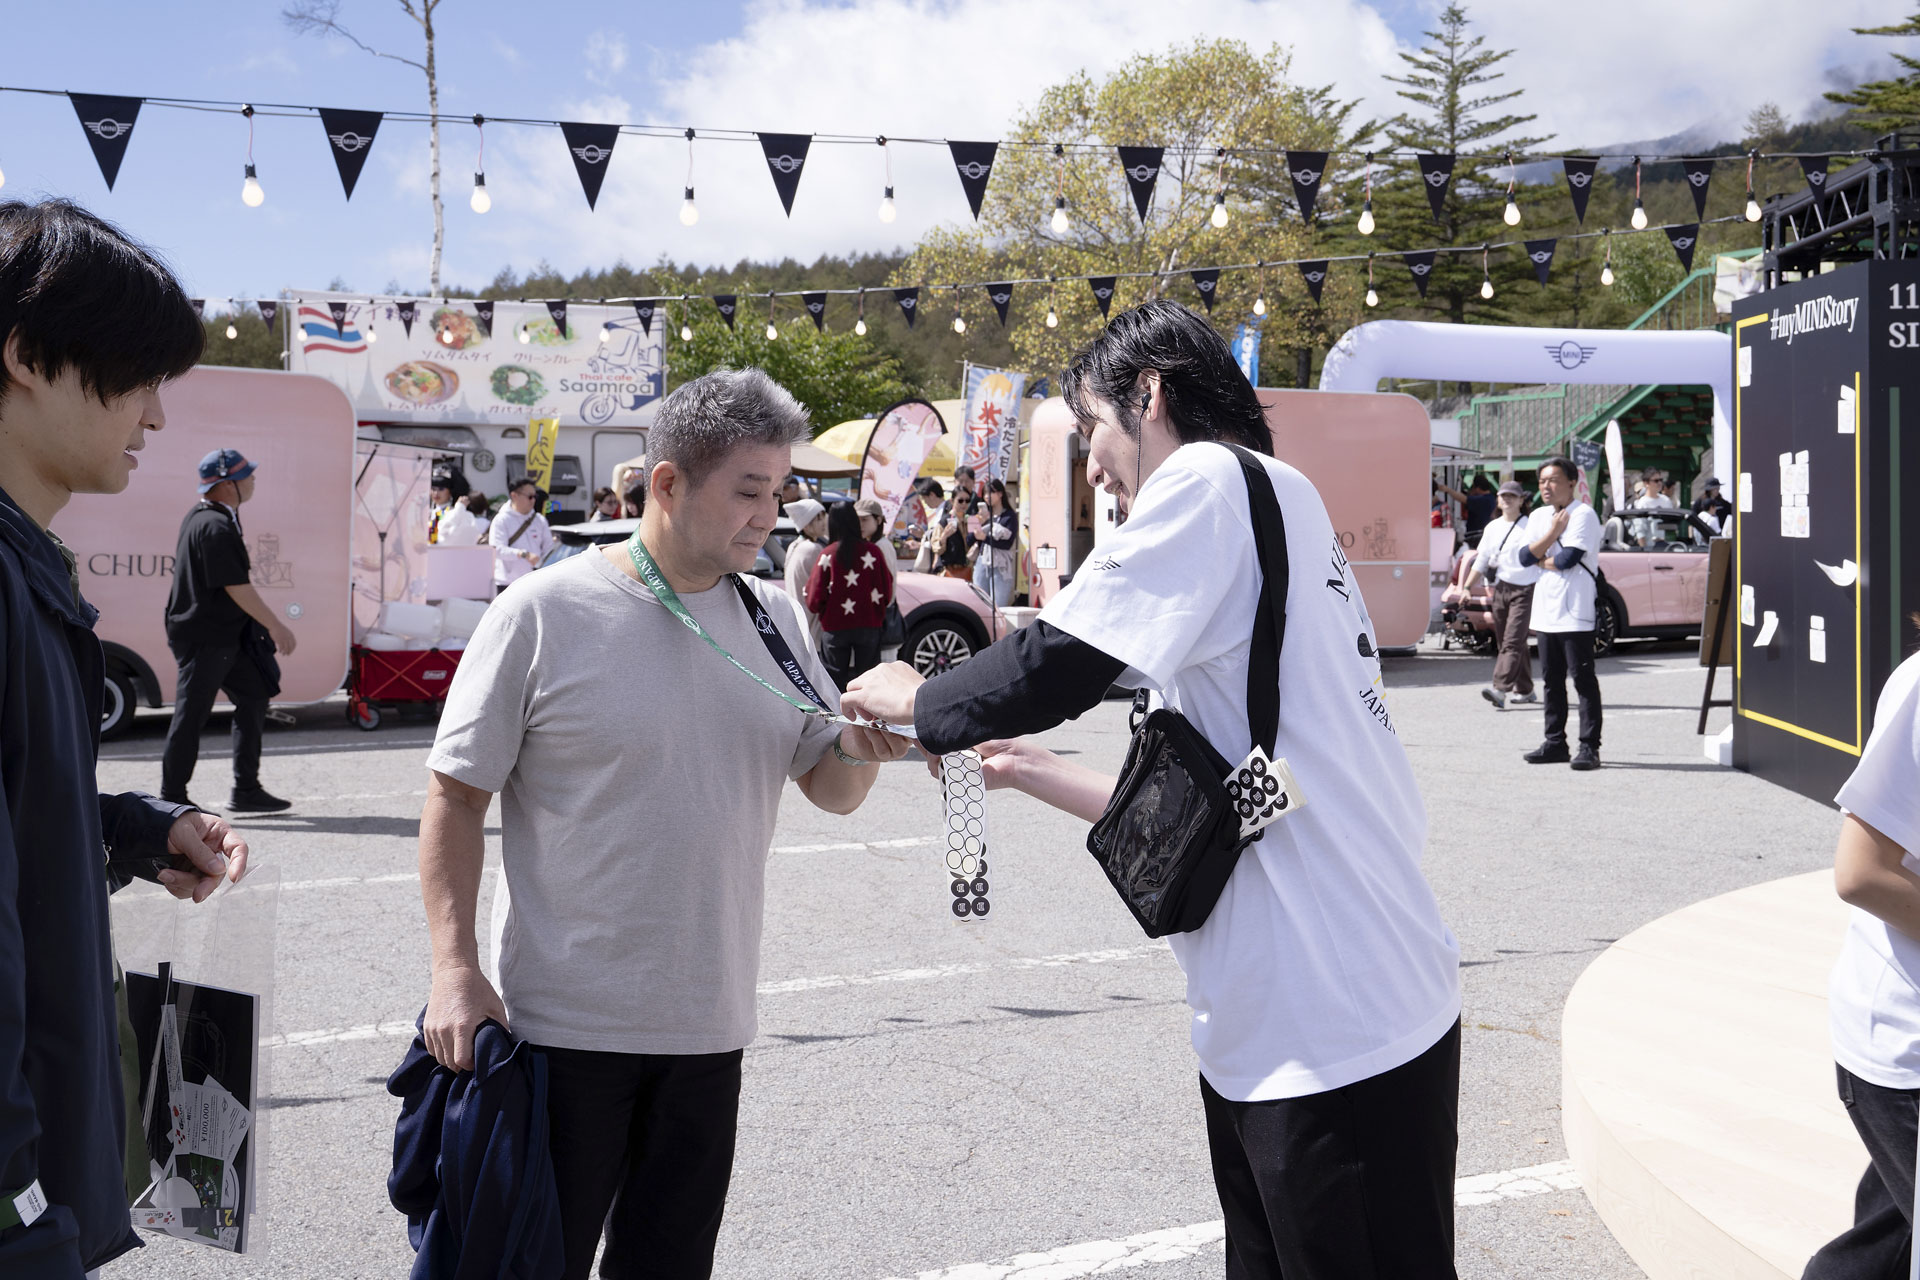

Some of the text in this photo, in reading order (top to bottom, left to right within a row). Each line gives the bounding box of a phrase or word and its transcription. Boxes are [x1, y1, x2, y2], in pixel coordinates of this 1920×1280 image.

[100, 124, 117, 132] MINI
[1889, 283, 1920, 310] 11
[1770, 295, 1860, 345] #myMINIStory
[1562, 351, 1580, 359] MINI
[560, 378, 651, 394] Saamroa
[579, 373, 604, 381] Thai
[639, 560, 666, 591] JAPAN
[782, 660, 804, 685] JAPAN
